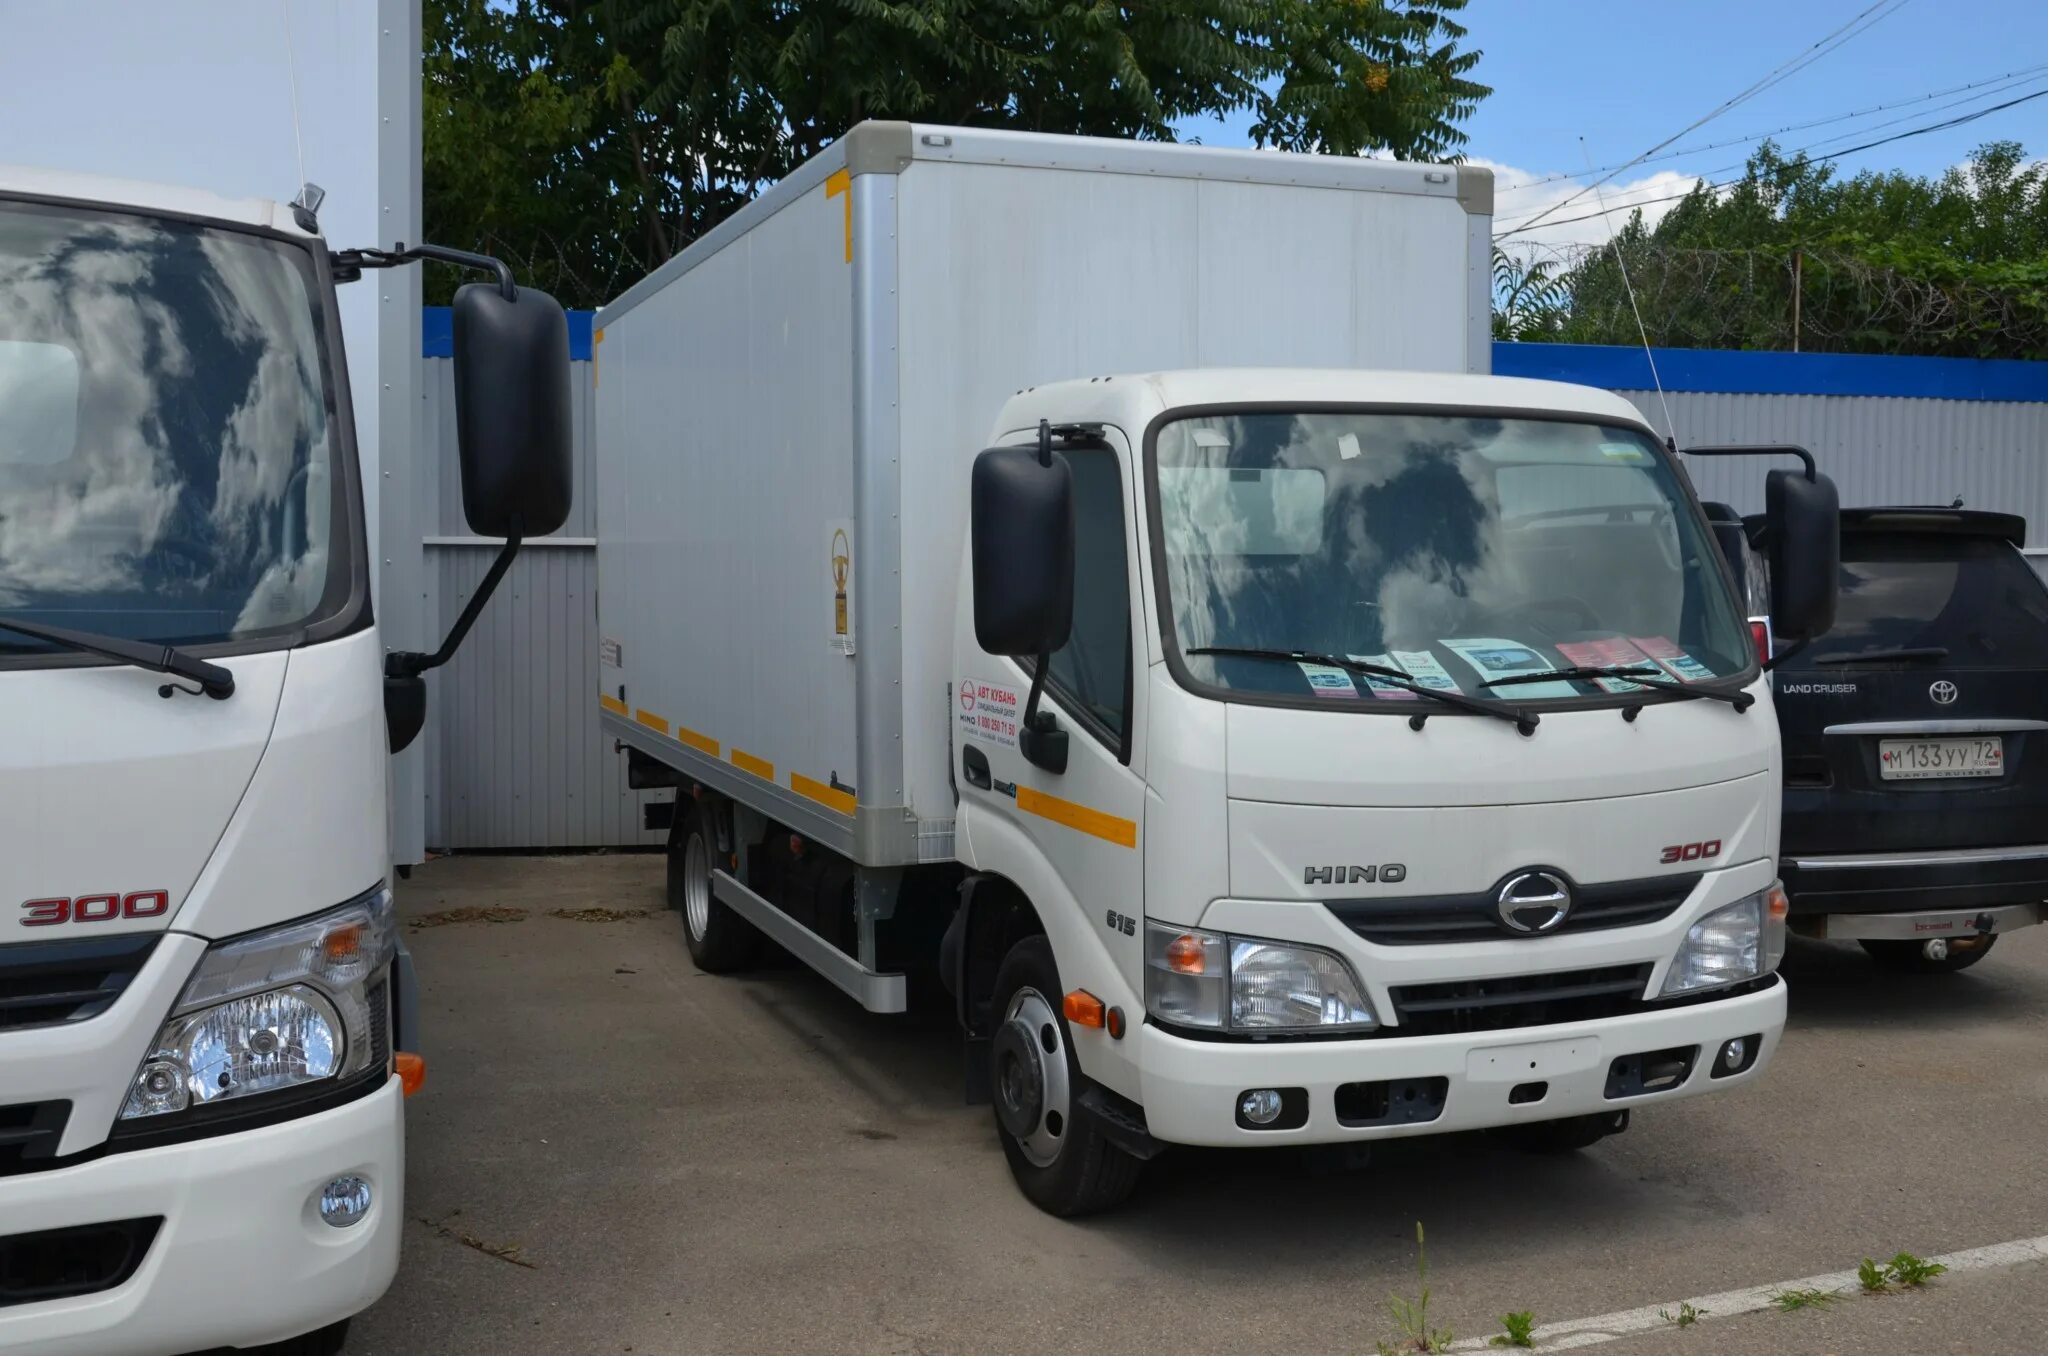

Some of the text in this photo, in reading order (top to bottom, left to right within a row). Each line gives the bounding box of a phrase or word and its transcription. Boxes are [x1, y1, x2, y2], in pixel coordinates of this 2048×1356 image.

[977, 686, 1017, 705] АВТ КУБАНЬ
[1783, 684, 1857, 694] LAND CRUISER
[960, 714, 976, 725] HINO
[1974, 741, 1994, 759] 72
[1659, 839, 1722, 864] 300
[1304, 863, 1407, 884] HINO
[19, 889, 169, 926] 300
[1106, 909, 1136, 936] 615
